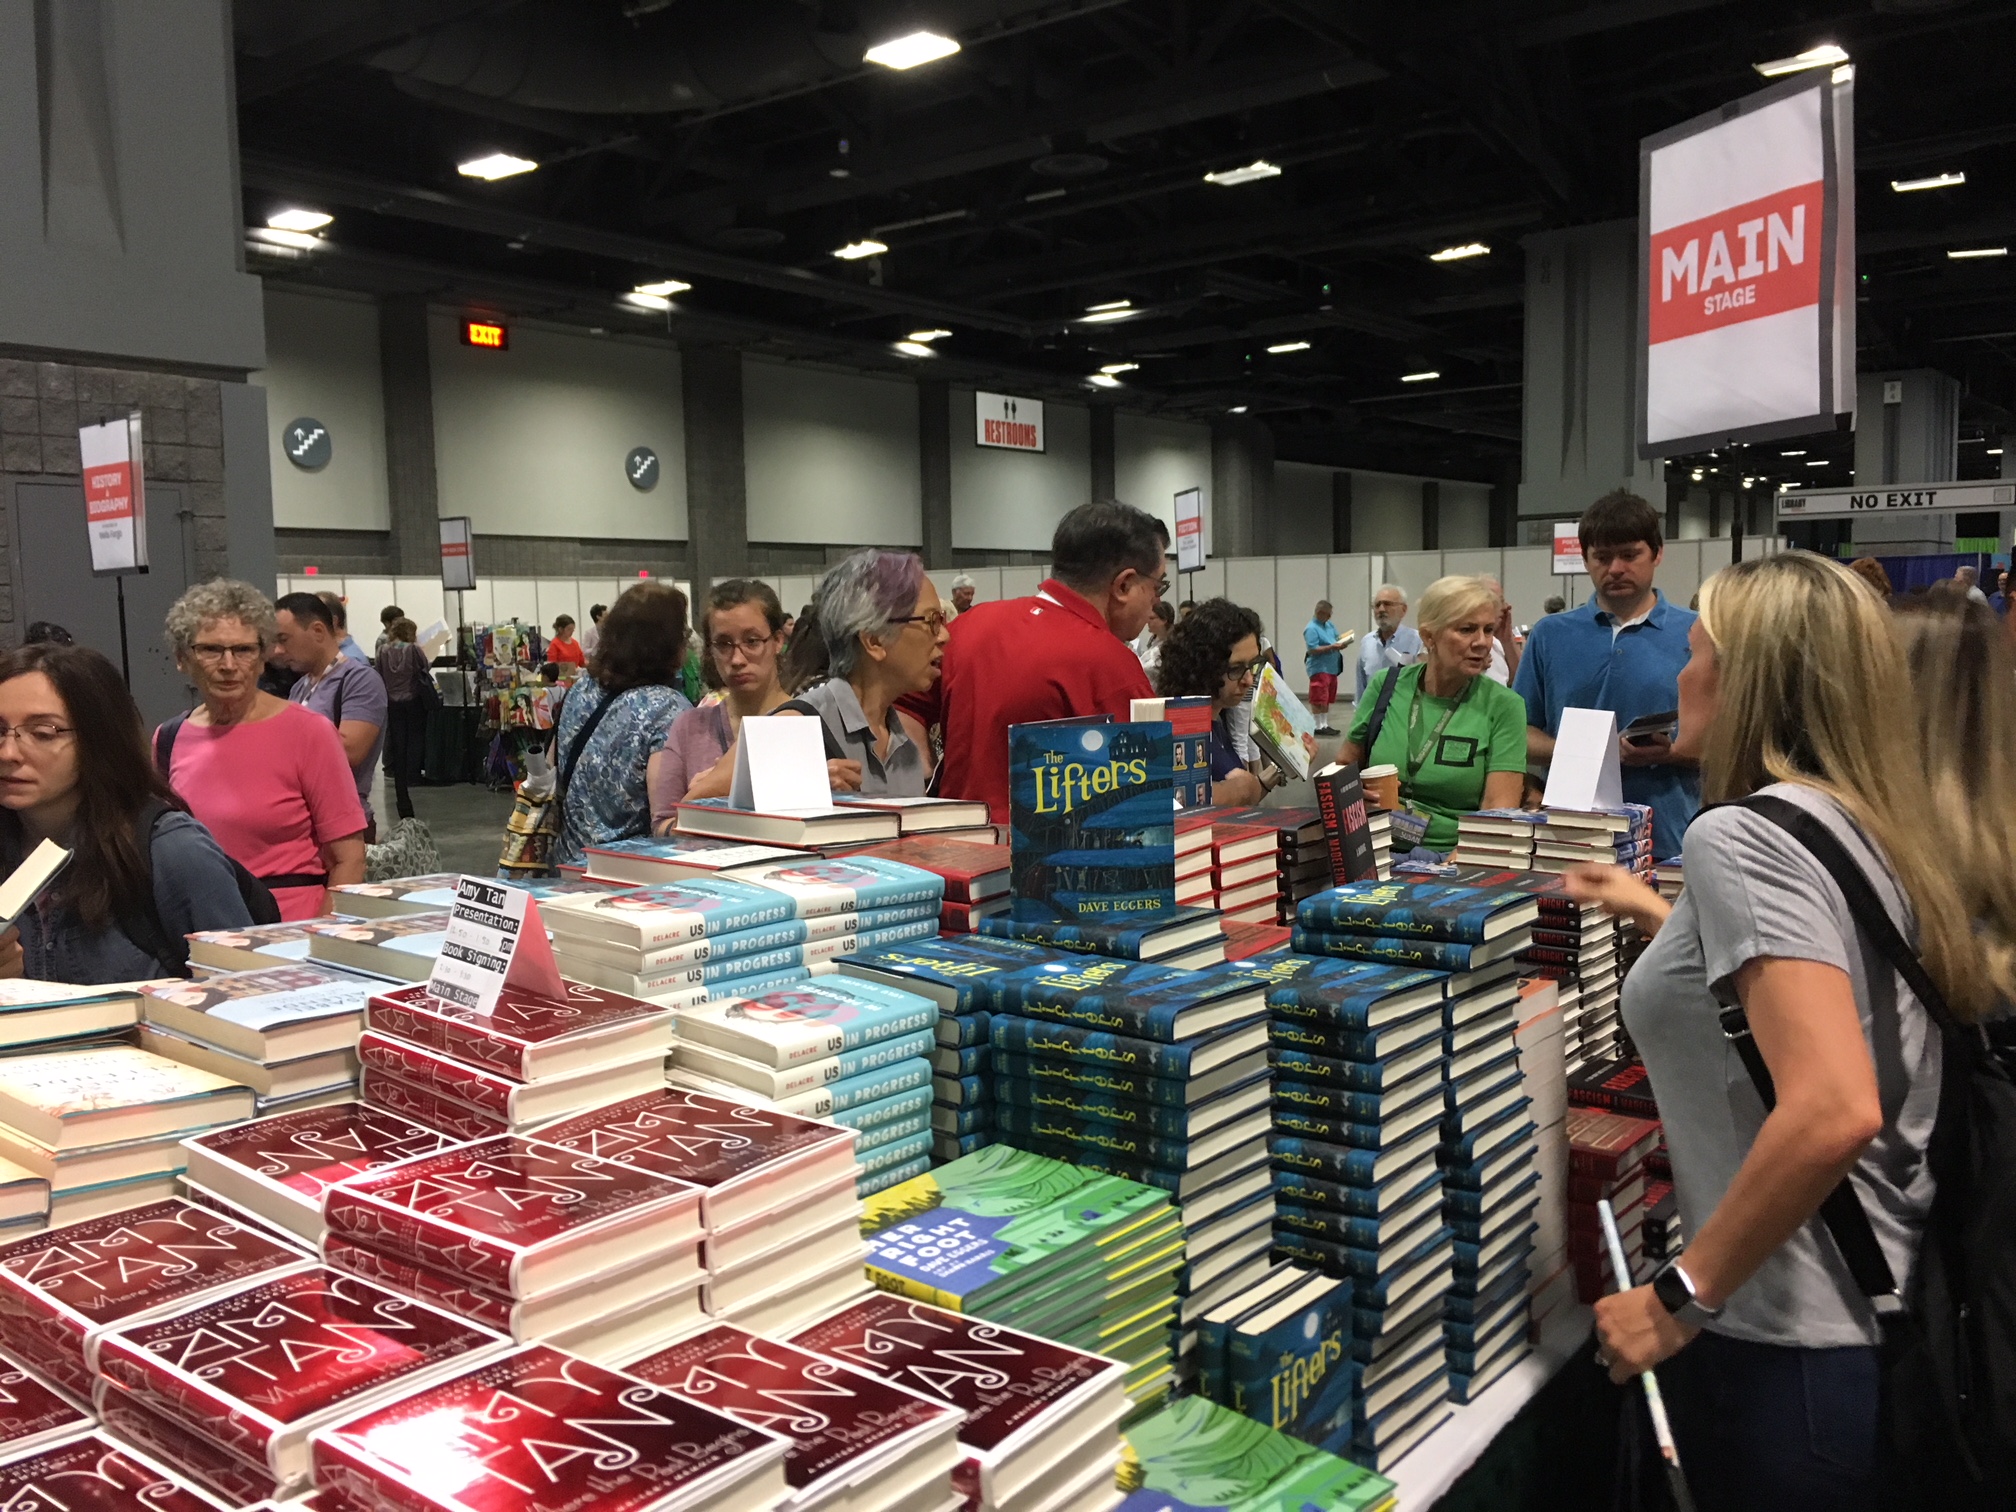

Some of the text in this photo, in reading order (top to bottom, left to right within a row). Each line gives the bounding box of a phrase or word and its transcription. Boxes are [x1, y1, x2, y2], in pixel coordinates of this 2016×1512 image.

[1662, 204, 1805, 302] MAIN
[1704, 284, 1756, 315] STAGE
[470, 324, 501, 346] EXIT
[985, 418, 1036, 447] RESTROOMS
[91, 472, 122, 489] HISTORY
[89, 497, 129, 514] BIOGRAPHY
[1850, 491, 1937, 509] NO EXIT
[1043, 750, 1064, 764] The
[1031, 758, 1147, 815] Lifters
[1318, 781, 1347, 887] FASCISM MADELEIN
[1342, 798, 1368, 835] FASCISM
[1400, 831, 1422, 844] SUSAN
[458, 881, 507, 908] Amy Tan
[806, 889, 934, 915] DELACRE US IN PROGRESS
[1078, 899, 1161, 913] DAVE EGGERS
[453, 903, 518, 932] Presentation:
[653, 906, 786, 943] DELACRE US IN PROGRESS
[812, 905, 932, 935] DELACRE US IN PROGRESS
[1339, 917, 1433, 934] Lifters
[442, 941, 507, 973] Book Signing:
[501, 939, 514, 953] pm
[655, 930, 796, 965] DELACRE US IN PROGRESS
[811, 923, 929, 955] DELACRE US IN PROGRESS
[647, 951, 791, 988] DELACRE US IN PROGRESS
[1039, 962, 1127, 992] Lifters
[430, 980, 479, 1008] Main Stage
[1027, 1003, 1124, 1028] Lifters
[443, 1022, 511, 1074] TAN
[789, 1012, 929, 1060] DELACRE US IN PROGRESS
[1033, 1039, 1136, 1064] Lifters
[432, 1063, 494, 1102] TAN
[786, 1039, 925, 1090] DELACRE US IN PROGRESS
[1033, 1066, 1134, 1092] Lifters
[815, 1100, 831, 1114] US
[835, 1095, 849, 1108] IN
[854, 1072, 920, 1102] PROGRESS
[1036, 1095, 1136, 1122] Lifters
[1568, 1088, 1611, 1105] FASCISM
[555, 1093, 717, 1160] AMY
[856, 1097, 922, 1128] PROGRESS
[256, 1125, 429, 1176] TAN
[609, 1106, 773, 1163] TAN
[855, 1118, 919, 1150] PROGRESS
[1037, 1124, 1136, 1152] Lifters
[372, 1143, 558, 1211] AMY
[425, 1158, 613, 1217] TAN
[856, 1165, 919, 1197] PROGRESS
[0, 1207, 197, 1281] AMY
[867, 1224, 922, 1251] HER
[879, 1217, 970, 1259] RIGHT
[898, 1230, 976, 1267] FOOT
[919, 1238, 989, 1272] DAVE EGGERS
[36, 1225, 238, 1290] TAN
[73, 1252, 289, 1310] Where the Past Begins
[143, 1277, 362, 1367] AMY
[192, 1298, 415, 1380] TAN
[830, 1303, 953, 1370] MY
[906, 1323, 1025, 1399] AN
[1006, 1377, 1054, 1397] Past
[1031, 1355, 1093, 1381] Begins
[244, 1379, 330, 1405] Where
[325, 1366, 364, 1380] the
[723, 1362, 856, 1433] AN
[1270, 1330, 1342, 1431] Lifters
[823, 1422, 876, 1444] Past
[857, 1400, 926, 1427] Begins
[587, 1428, 752, 1493] the Past Begins
